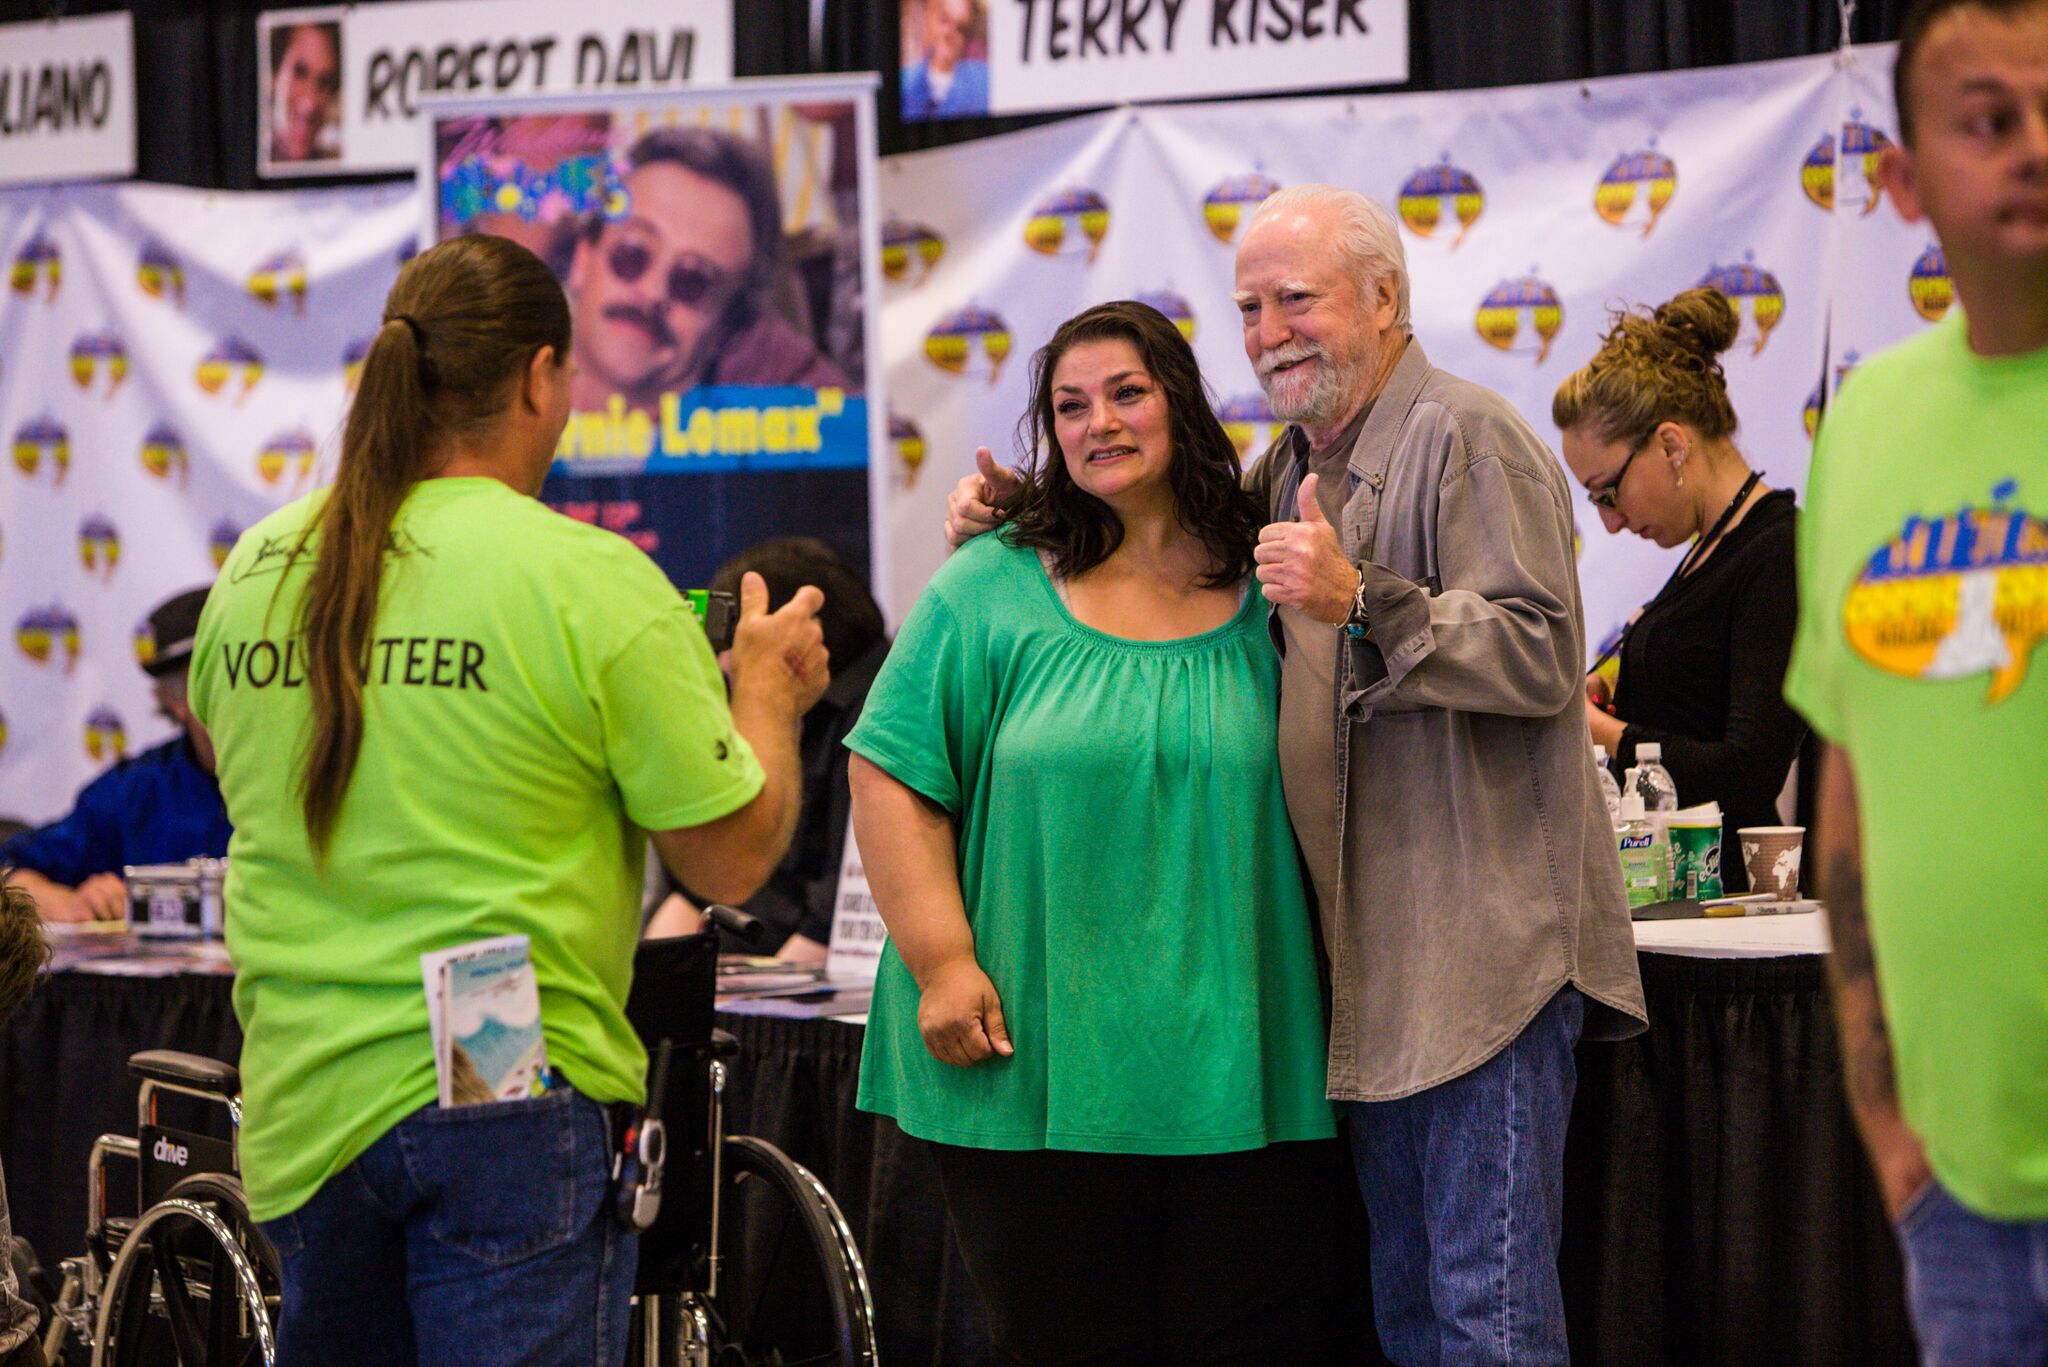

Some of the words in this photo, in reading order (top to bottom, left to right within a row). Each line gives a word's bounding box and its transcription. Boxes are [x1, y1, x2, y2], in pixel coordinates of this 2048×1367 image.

[222, 637, 487, 691] VOLNTEER
[1624, 837, 1650, 848] Purell
[153, 1135, 189, 1167] drive
